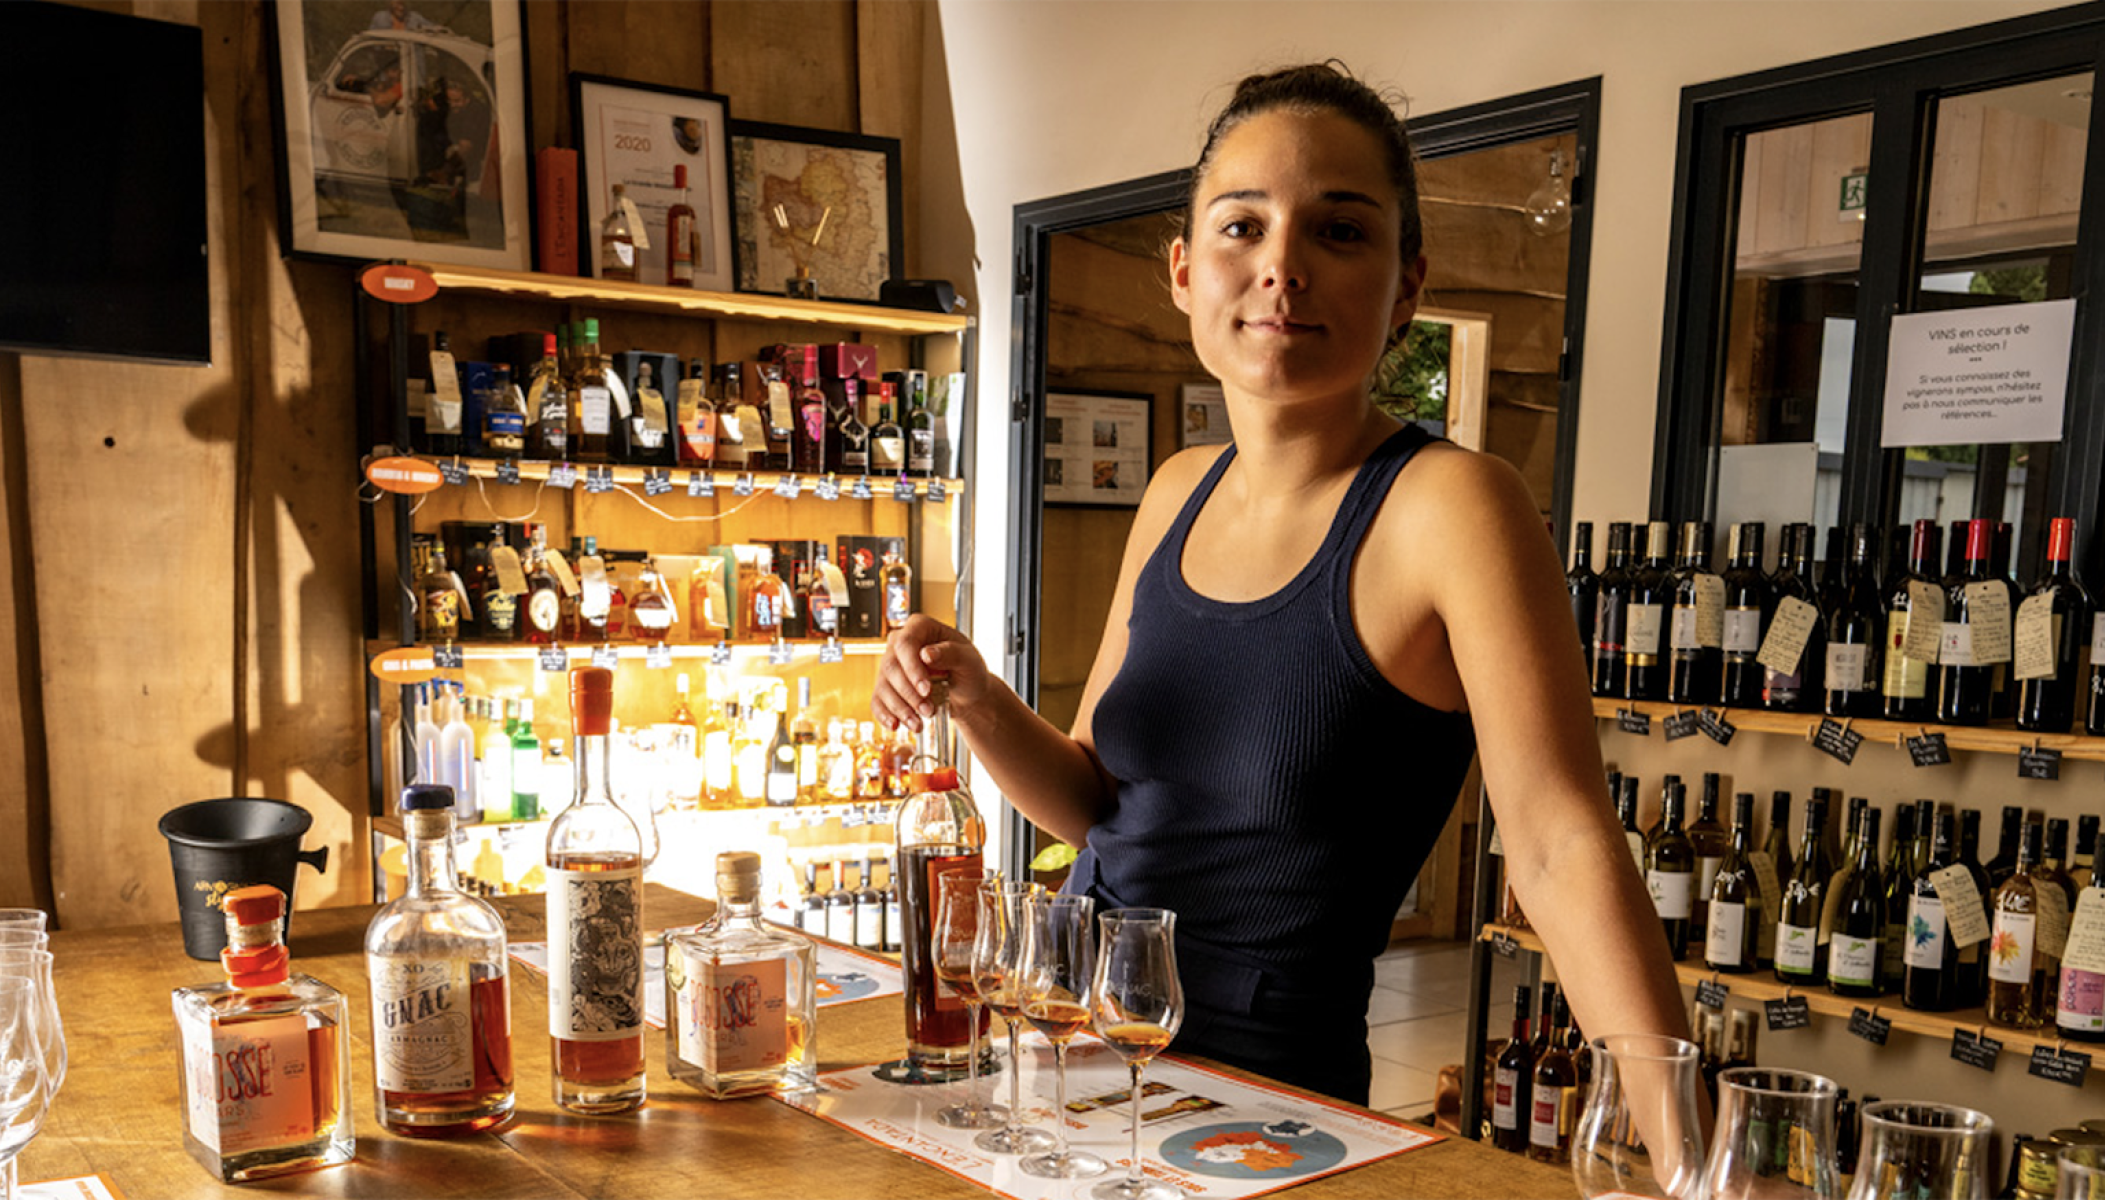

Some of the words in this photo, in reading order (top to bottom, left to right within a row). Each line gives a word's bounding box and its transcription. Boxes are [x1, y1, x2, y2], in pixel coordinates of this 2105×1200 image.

[614, 134, 651, 151] 2020
[1929, 328, 1957, 341] VINS
[1959, 330, 1975, 339] en
[1977, 326, 2011, 338] cours
[2014, 323, 2030, 334] de
[1948, 341, 2000, 355] sélection
[1919, 375, 1928, 384] Si
[1931, 374, 1953, 384] vous
[1955, 371, 2010, 382] connaissez
[2012, 369, 2031, 379] des
[1906, 387, 1953, 399] vignerons
[1996, 382, 2042, 393] n'hésitez
[1902, 401, 1921, 411] pas
[1923, 400, 1930, 409] à
[1931, 399, 1954, 408] nous
[1957, 396, 2025, 407] communiquer
[2028, 394, 2043, 403] les
[402, 963, 424, 973] XO
[383, 982, 452, 1028] GNAC
[390, 1035, 448, 1043] ARMAGNAC
